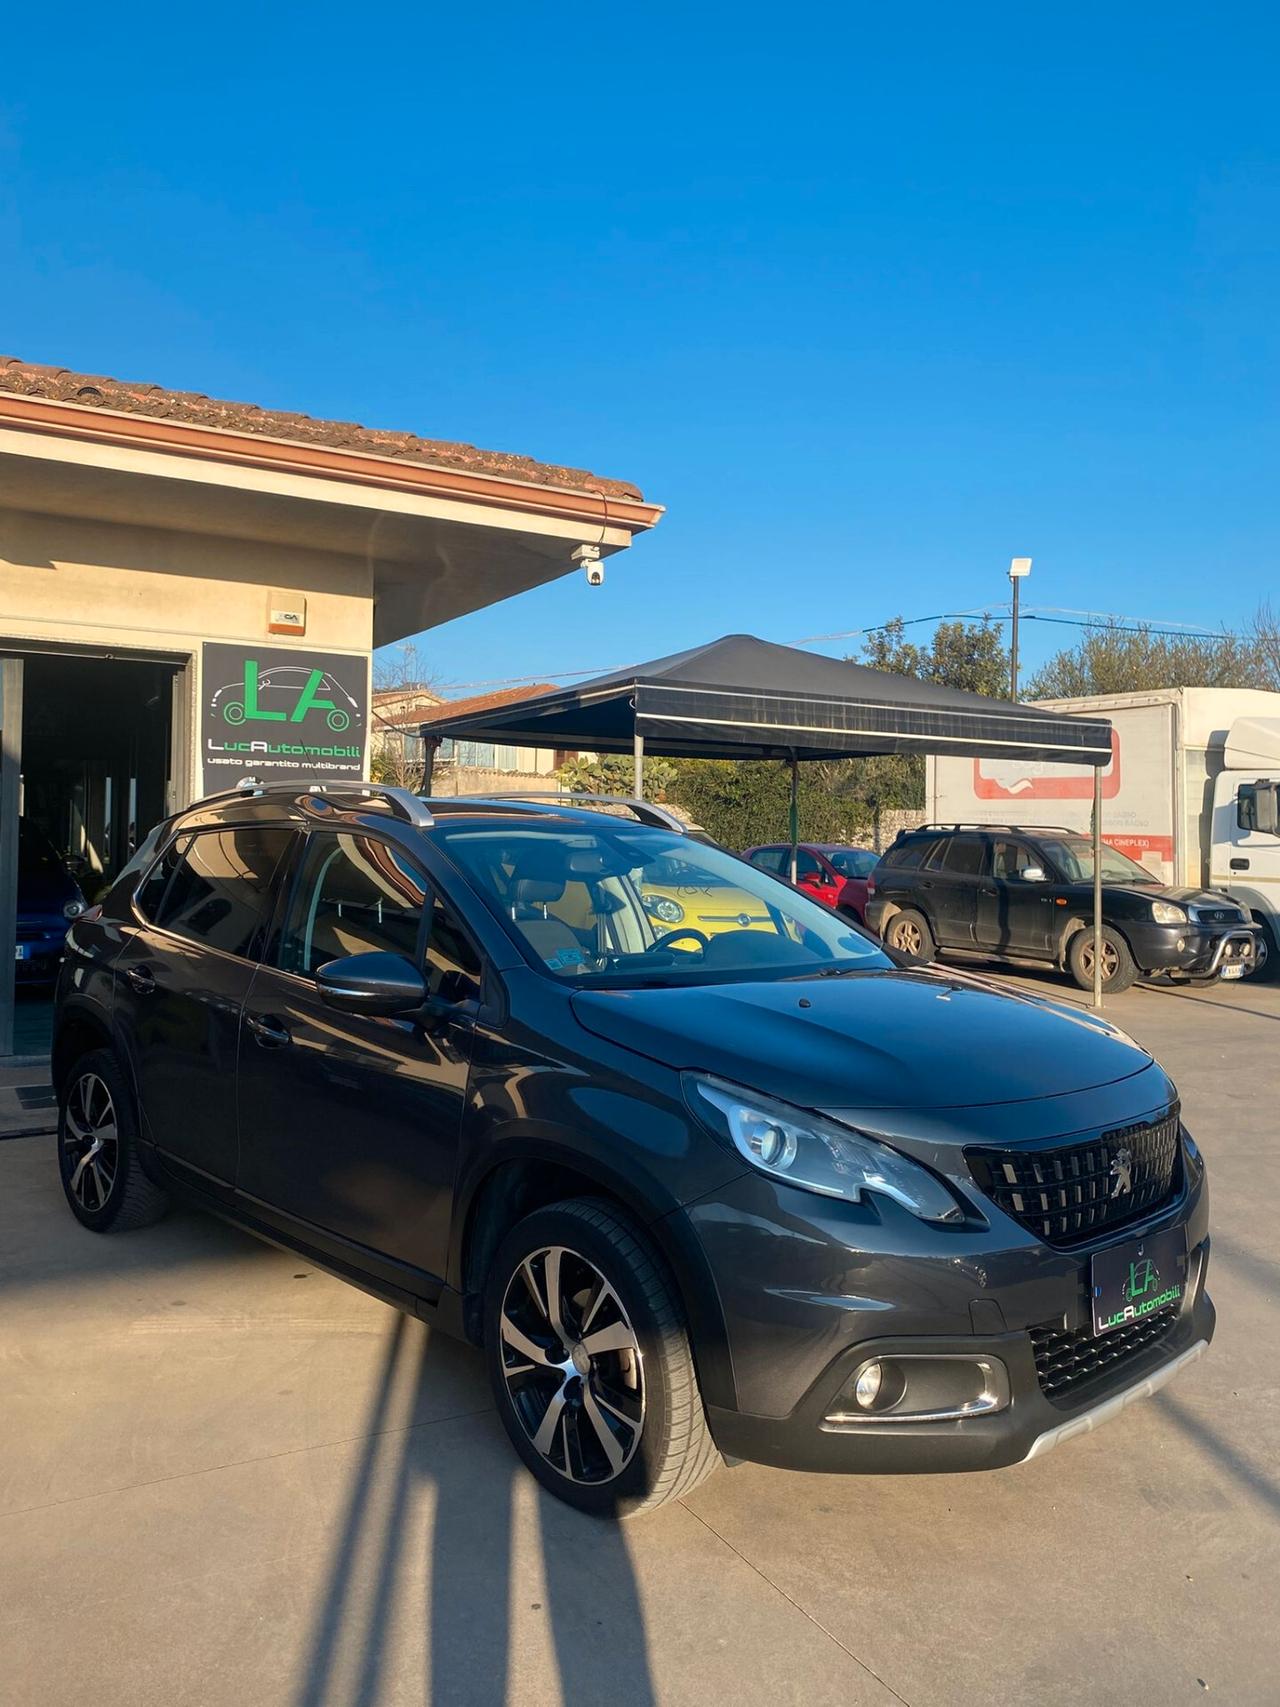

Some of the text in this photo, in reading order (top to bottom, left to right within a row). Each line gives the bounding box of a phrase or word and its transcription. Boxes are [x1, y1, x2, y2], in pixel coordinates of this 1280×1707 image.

[207, 738, 361, 758] LucAutomobili
[207, 757, 361, 771] usato garantito multibrand
[1098, 1284, 1181, 1331] LucAutomobili
